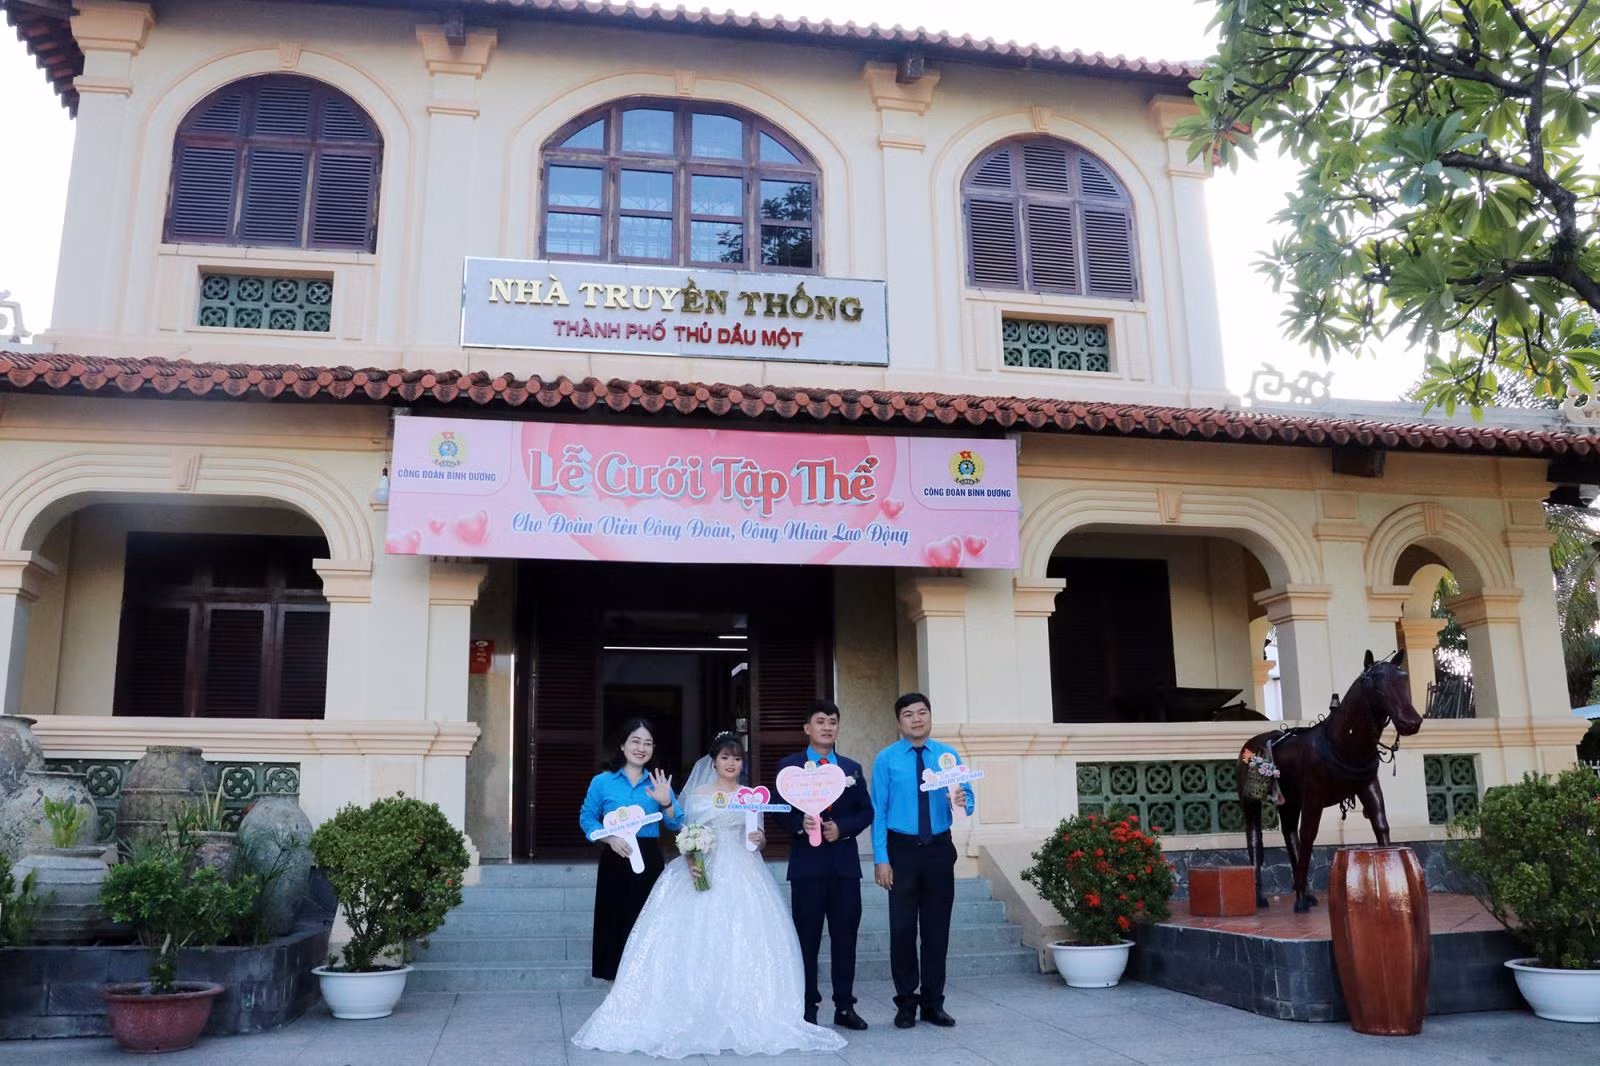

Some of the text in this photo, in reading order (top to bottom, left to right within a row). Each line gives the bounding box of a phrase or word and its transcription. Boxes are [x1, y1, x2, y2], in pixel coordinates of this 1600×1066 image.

[489, 274, 864, 322] NHÀ TRUYỀN THỐNG
[553, 318, 803, 349] THÀNH PHỐ THỦ DẦU MỘT
[397, 468, 420, 479] CÔNG
[528, 445, 880, 518] Lễ Cưới Tập Thể
[924, 487, 944, 497] CÔNG
[945, 487, 966, 497] ĐOÀN
[986, 488, 1012, 498] DƯƠNG
[512, 512, 909, 547] Cho Đoàn Viên Công Đoàn, Công Nhân Lao Động
